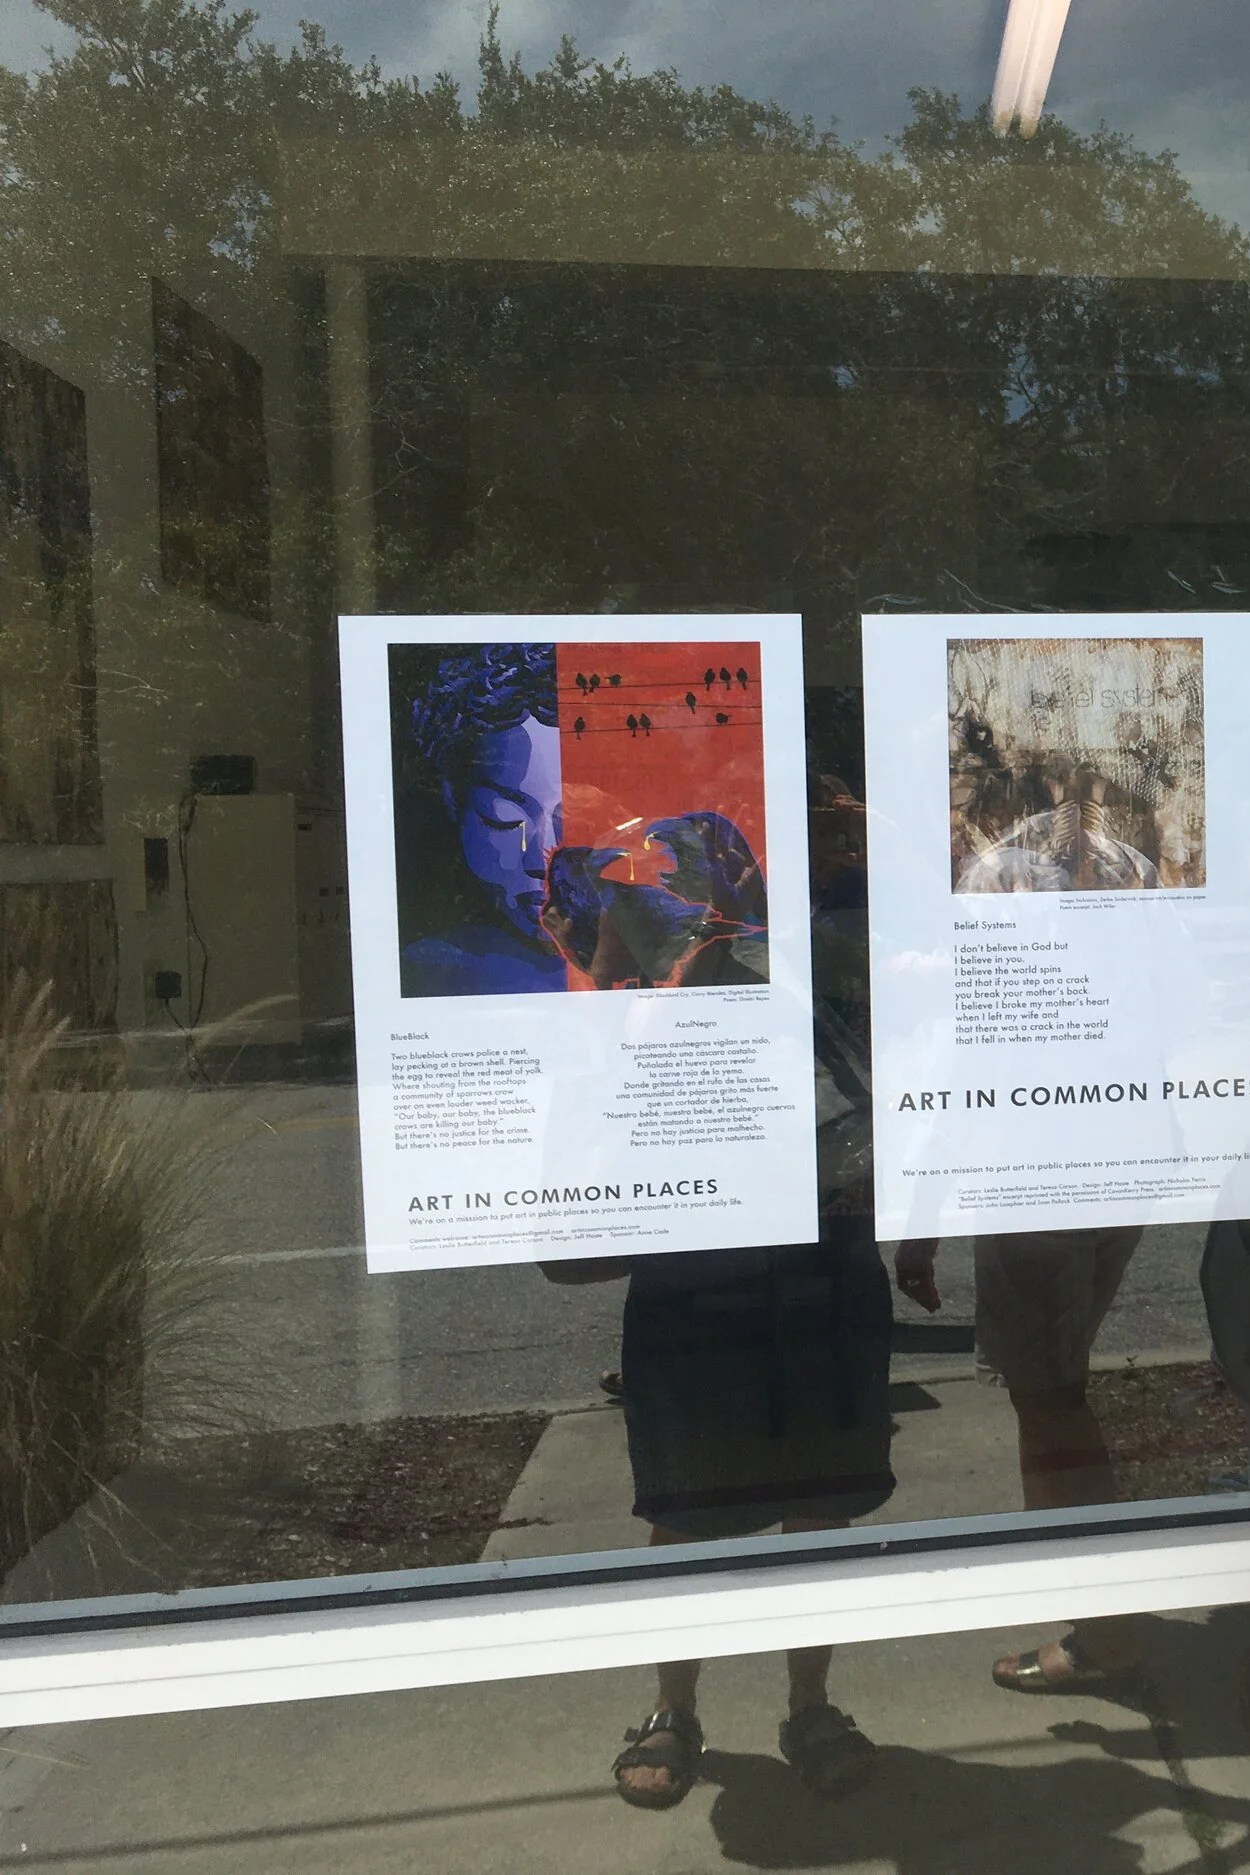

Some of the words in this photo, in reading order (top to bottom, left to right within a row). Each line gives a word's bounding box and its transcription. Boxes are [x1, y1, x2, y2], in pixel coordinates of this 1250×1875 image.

[954, 920, 979, 930] Belief
[982, 920, 1016, 932] Systems
[954, 944, 957, 953] I
[960, 943, 984, 953] don't
[986, 943, 1018, 952] believe
[1021, 942, 1029, 951] in
[1032, 942, 1051, 951] God
[1054, 942, 1068, 951] but
[954, 956, 958, 965] I
[960, 955, 992, 964] believe
[995, 955, 1003, 964] in
[1006, 957, 1025, 966] you.
[955, 967, 958, 976] I
[961, 966, 992, 976] believe
[995, 966, 1009, 975] the
[1012, 965, 1037, 974] world
[1040, 964, 1062, 976] spins
[955, 978, 972, 987] and
[975, 977, 992, 987] that
[995, 977, 1001, 986] if
[1003, 979, 1019, 988] you
[1023, 976, 1040, 988] step
[1066, 975, 1089, 984] crack
[955, 992, 973, 1001] you
[973, 989, 1000, 998] break
[1002, 991, 1023, 1000] your
[1026, 987, 1064, 997] mother's
[956, 1001, 958, 1010] I
[961, 1000, 993, 1010] believe
[996, 1000, 999, 1009] I
[1002, 999, 1027, 1008] broke
[1029, 1001, 1043, 1010] my
[1046, 998, 1084, 1008] mother's
[1086, 997, 1109, 1006] heart
[956, 1012, 980, 1021] when
[982, 1012, 987, 1021] I
[988, 1011, 1002, 1021] left
[1005, 1014, 1018, 1022] my
[1020, 1010, 1039, 1020] wife
[1042, 1010, 1059, 1019] and
[956, 1024, 973, 1033] that
[976, 1023, 998, 1032] there
[1030, 1021, 1054, 1031] crack
[1056, 1021, 1064, 1030] in
[1067, 1020, 1080, 1030] the
[1083, 1019, 1108, 1029] world
[956, 1035, 973, 1044] that
[976, 1035, 979, 1044] I
[982, 1034, 995, 1044] fell
[998, 1034, 1006, 1043] in
[1009, 1033, 1032, 1043] when
[1035, 1035, 1048, 1044] my
[1051, 1032, 1081, 1041] mother
[1084, 1031, 1105, 1040] died.
[899, 1091, 951, 1112] ART
[967, 1089, 995, 1108] IN
[1011, 1083, 1147, 1107] COMMON
[952, 1166, 983, 1174] mission
[997, 1165, 1010, 1173] put
[1038, 1162, 1063, 1171] public
[1065, 1162, 1091, 1170] places
[1140, 1157, 1181, 1165] encounter
[1201, 1156, 1220, 1164] your
[1222, 1154, 1242, 1162] daily
[409, 1195, 453, 1212] ART
[466, 1193, 491, 1208] IN
[504, 1185, 620, 1206] COMMON
[634, 1179, 717, 1198] PLACES
[456, 1214, 488, 1222] mission
[500, 1212, 513, 1221] put
[538, 1210, 562, 1219] public
[564, 1209, 589, 1217] places
[634, 1203, 672, 1211] encounter
[690, 1202, 708, 1210] your
[709, 1200, 728, 1208] daily
